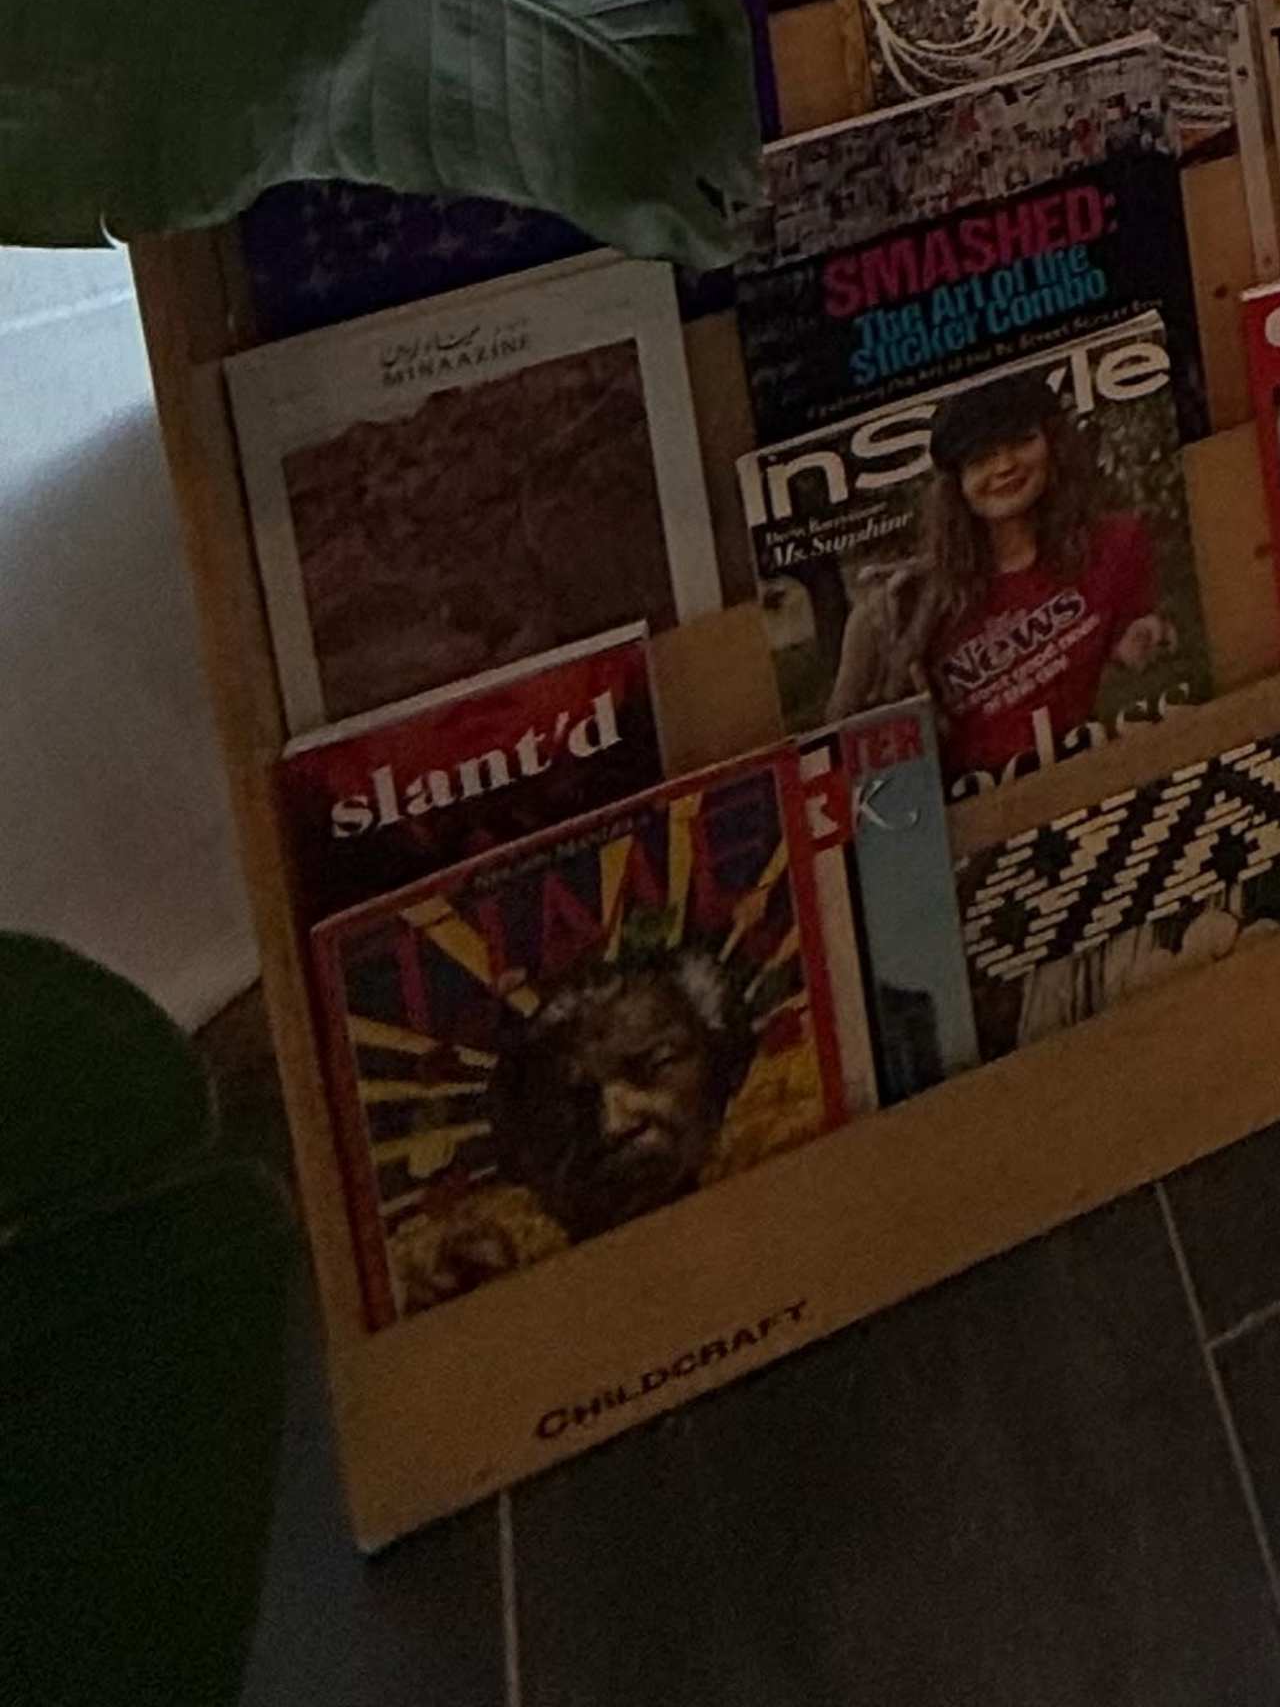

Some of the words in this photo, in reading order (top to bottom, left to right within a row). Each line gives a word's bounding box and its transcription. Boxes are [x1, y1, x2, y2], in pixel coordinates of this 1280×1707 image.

[824, 186, 1119, 318] SMASHED:
[854, 303, 924, 352] The
[931, 276, 986, 325] Art
[991, 262, 1027, 303] of
[1030, 243, 1091, 280] the
[849, 313, 980, 388] Sticker
[985, 269, 1108, 337] Combo
[735, 341, 1172, 529] InSle
[330, 692, 624, 839] slant'd
[536, 1300, 807, 1440] CHILDCRAFT
